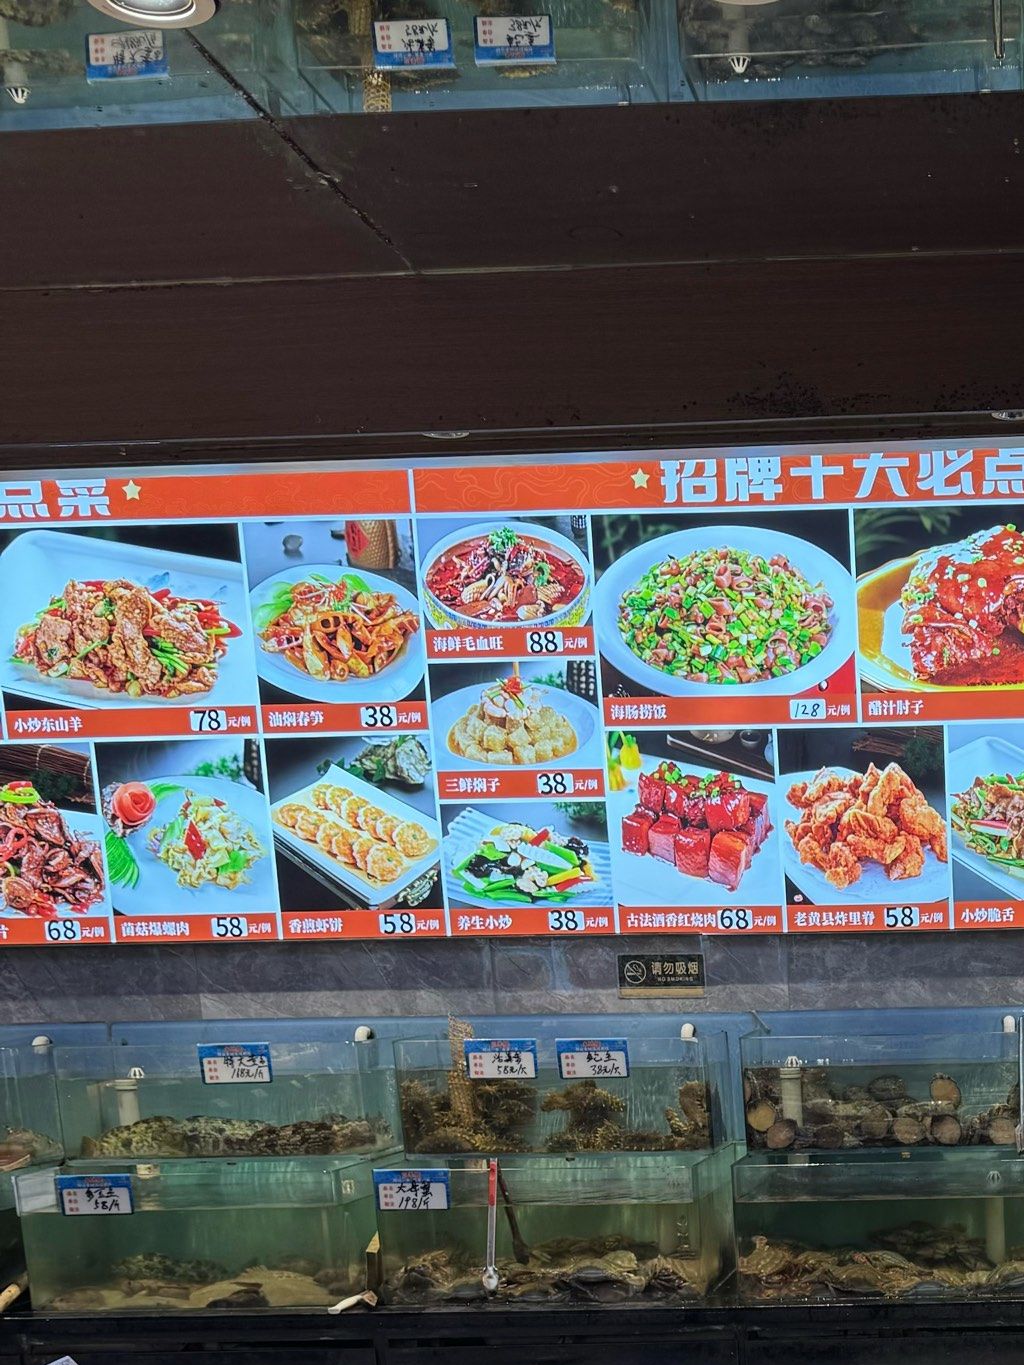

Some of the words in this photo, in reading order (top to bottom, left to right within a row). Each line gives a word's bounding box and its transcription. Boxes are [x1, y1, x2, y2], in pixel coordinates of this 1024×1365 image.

[432, 635, 505, 653] 海鲜毛血旺
[529, 630, 558, 654] 88
[13, 716, 83, 733] 小炒东山羊
[193, 709, 221, 732] 78
[364, 705, 393, 728] 38
[610, 703, 668, 721] 海肠捞饭
[538, 772, 567, 795] 38
[288, 917, 344, 934] 香煎虾饼
[383, 912, 413, 935] 58
[457, 914, 513, 931] 养生小炒
[550, 909, 578, 931] 38
[720, 908, 749, 930] 68
[886, 906, 914, 928] 58
[960, 907, 1015, 923] 小炒脆舌
[48, 918, 76, 941] 68
[216, 916, 243, 938] 58
[651, 960, 699, 976] 请勿吸烟
